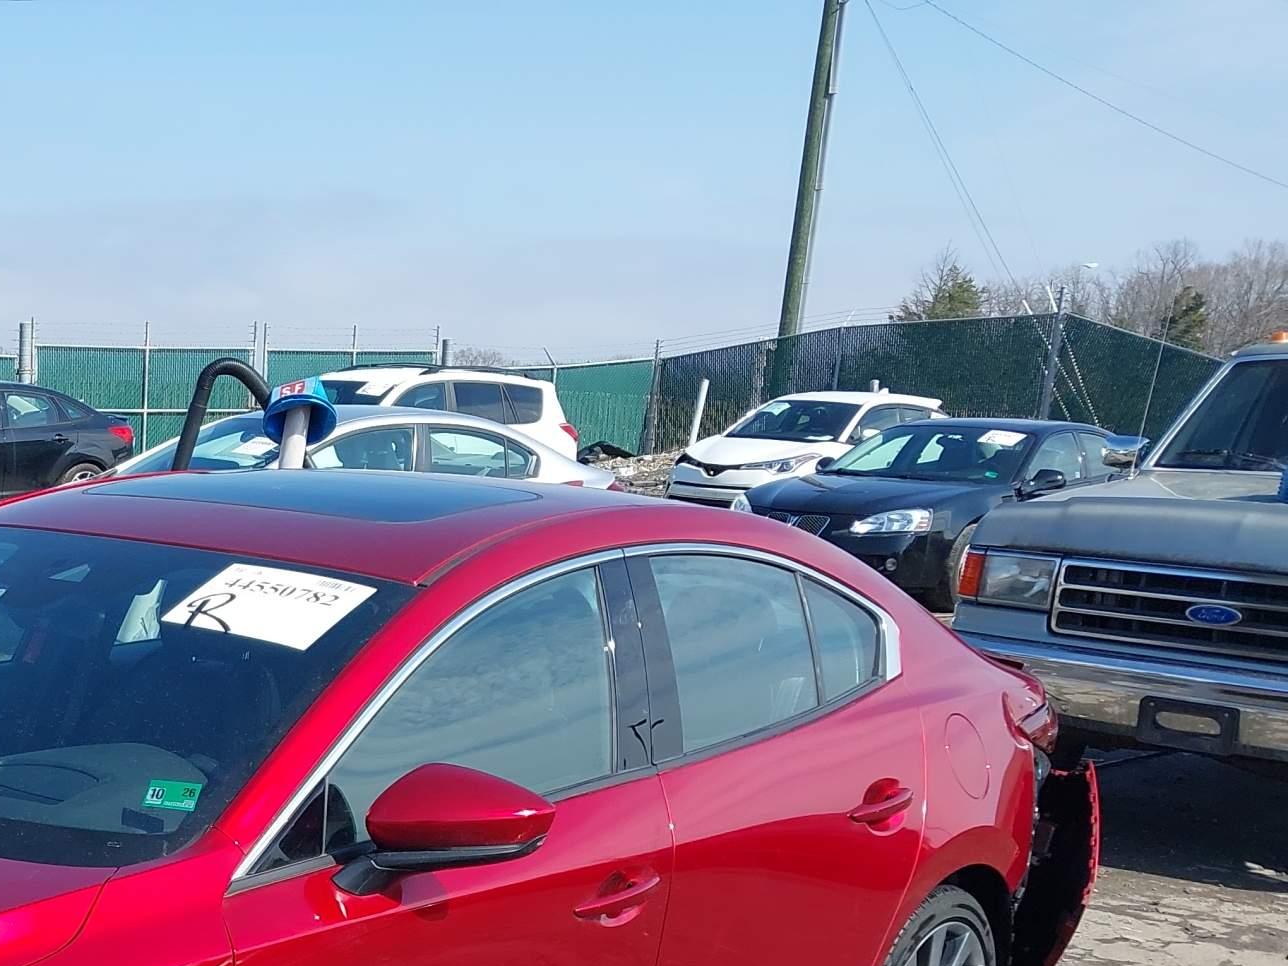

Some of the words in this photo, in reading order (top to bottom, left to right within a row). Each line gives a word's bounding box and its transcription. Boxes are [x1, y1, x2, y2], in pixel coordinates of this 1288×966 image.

[223, 578, 340, 607] 44550782
[183, 593, 237, 634] R
[150, 788, 166, 800] 10
[182, 788, 197, 798] 26
